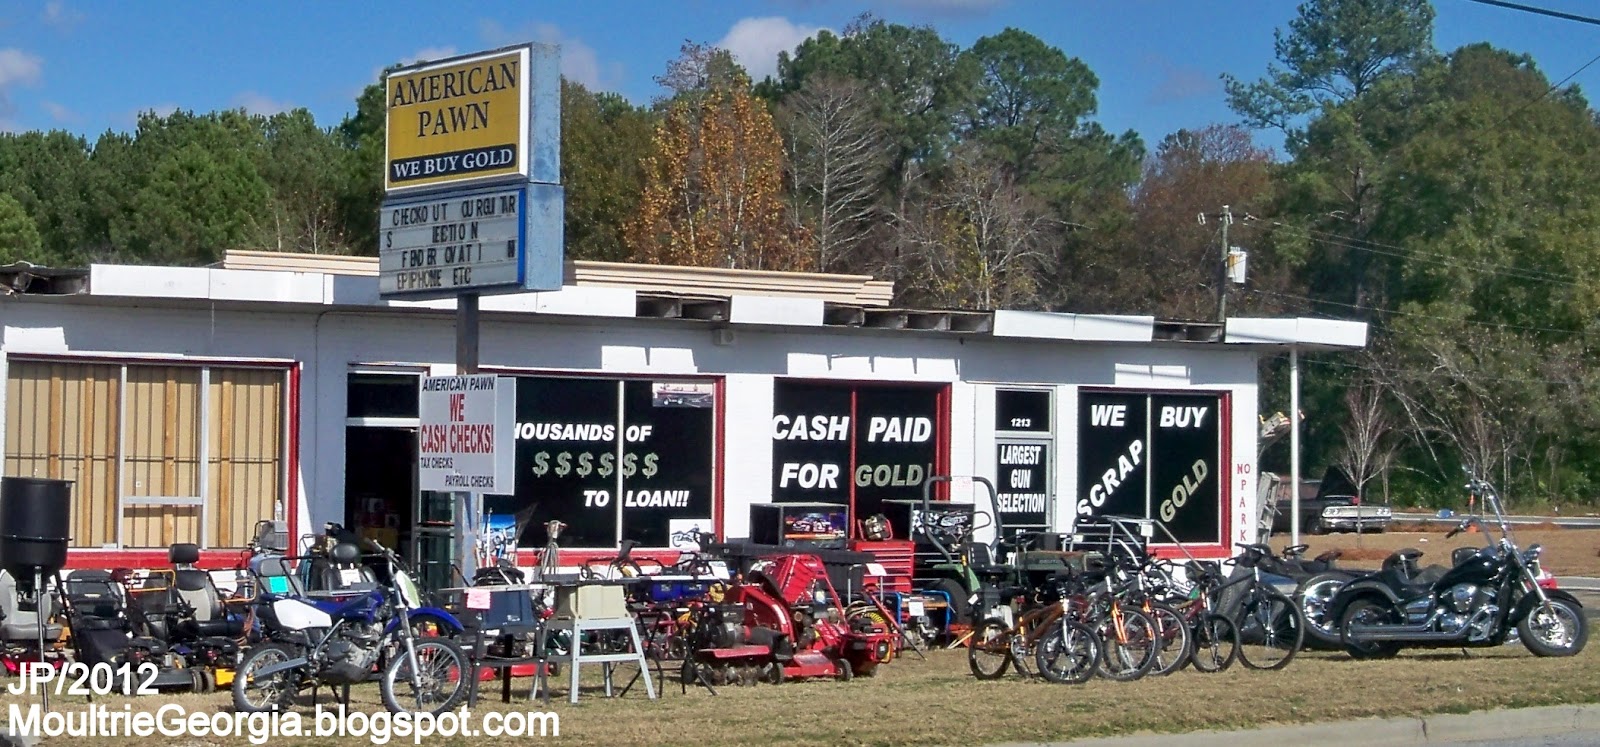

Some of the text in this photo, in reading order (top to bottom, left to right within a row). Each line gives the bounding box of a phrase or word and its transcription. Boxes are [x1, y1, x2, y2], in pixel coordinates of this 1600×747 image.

[391, 62, 518, 108] AMERICAN
[417, 100, 490, 138] PAWN
[393, 148, 513, 178] WE BUY GOLD
[453, 266, 472, 286] ETC
[422, 376, 494, 392] AMERICAN PAWN
[449, 393, 465, 422] WE
[1090, 404, 1208, 428] WE BUY
[772, 415, 932, 443] CASH PAID
[1011, 418, 1031, 428] 1213
[421, 423, 494, 454] CASH CHECKS!
[625, 425, 652, 442] OF
[421, 456, 453, 469] TAX CHECKS
[1000, 445, 1041, 465] LARGEST
[779, 463, 923, 489] FOR GOLD
[1236, 463, 1251, 475] NO
[445, 475, 494, 488] PAYROLL CHECKS
[1010, 470, 1031, 489] GUN
[1077, 439, 1143, 522] SCRAP
[583, 489, 690, 508] TO LOAN!!
[1160, 458, 1208, 523] GOLD
[997, 493, 1045, 513] SELECTION
